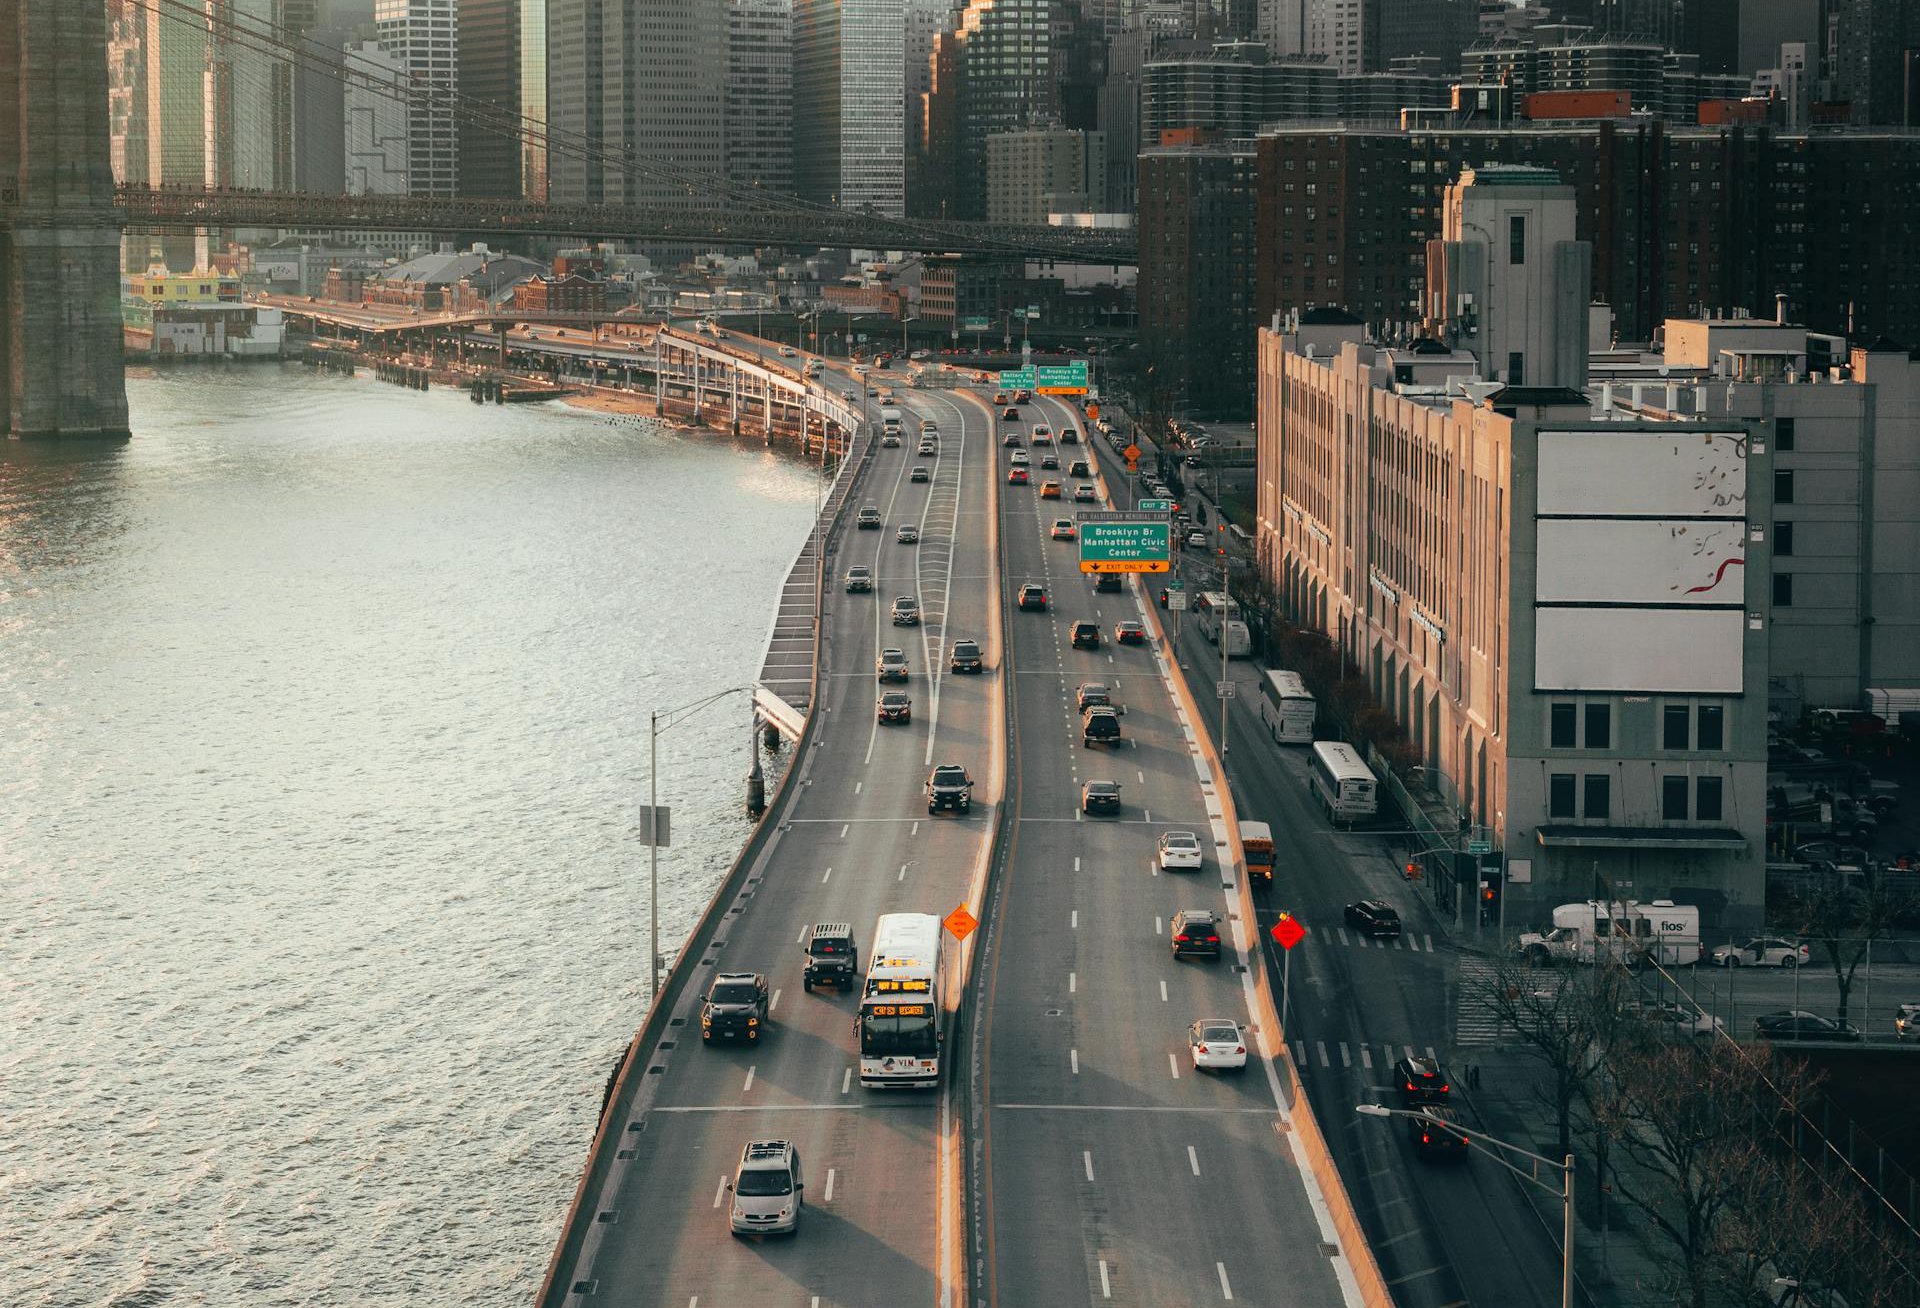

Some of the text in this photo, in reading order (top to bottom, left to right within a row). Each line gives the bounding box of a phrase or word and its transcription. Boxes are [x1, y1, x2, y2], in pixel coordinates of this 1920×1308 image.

[1095, 528, 1154, 537] Brooklyn Br
[1084, 538, 1165, 546] Manhattan Civic
[1108, 549, 1141, 557] Center
[1661, 921, 1683, 931] fios
